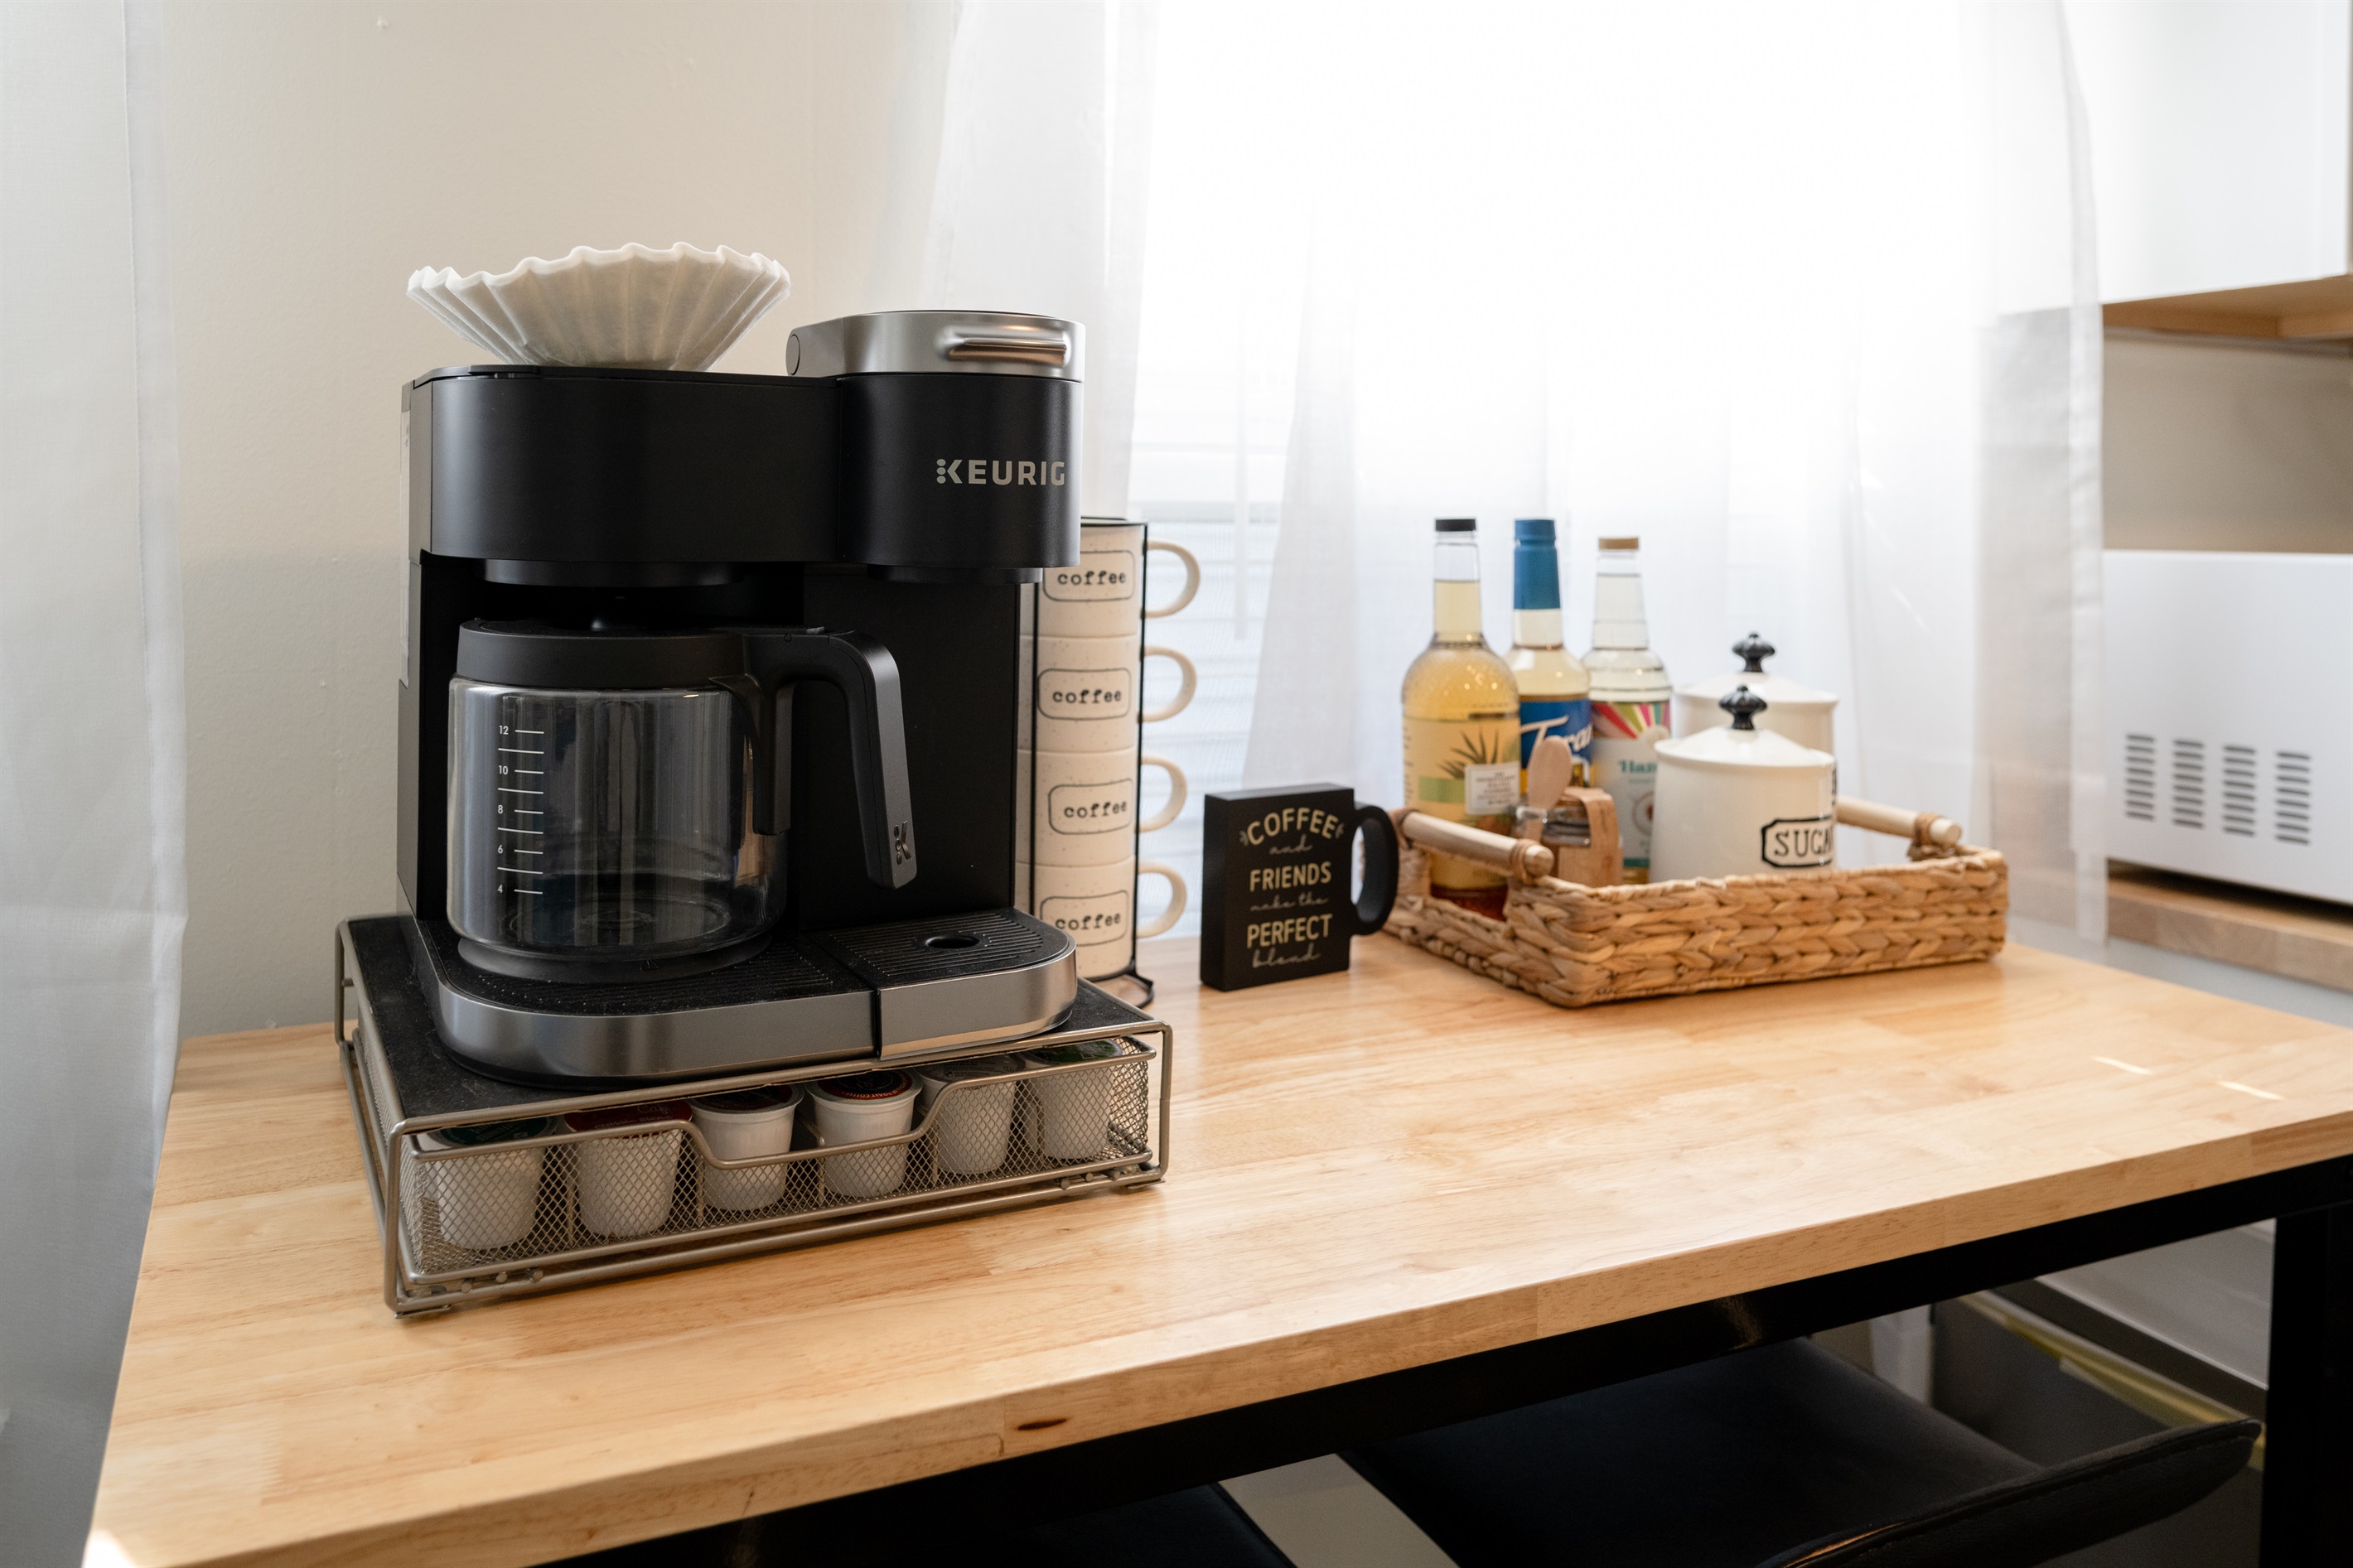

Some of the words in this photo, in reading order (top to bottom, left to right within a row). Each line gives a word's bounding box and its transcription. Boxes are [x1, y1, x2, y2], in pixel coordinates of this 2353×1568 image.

[936, 458, 1065, 486] KEURIG
[1057, 570, 1127, 586] coffee
[1051, 689, 1123, 704] coffee
[498, 725, 510, 736] 12
[498, 765, 509, 775] 10
[497, 804, 504, 814] 8
[1064, 801, 1128, 818] coffee
[1247, 807, 1339, 845] COFFEE
[497, 844, 504, 854] 6
[1268, 832, 1313, 856] and
[1249, 861, 1332, 893] FRIENDS
[497, 884, 504, 894] 4
[1297, 890, 1330, 907] the
[1055, 913, 1121, 930] coffee
[1246, 913, 1334, 949] PERFECT
[1252, 942, 1322, 968] blend
